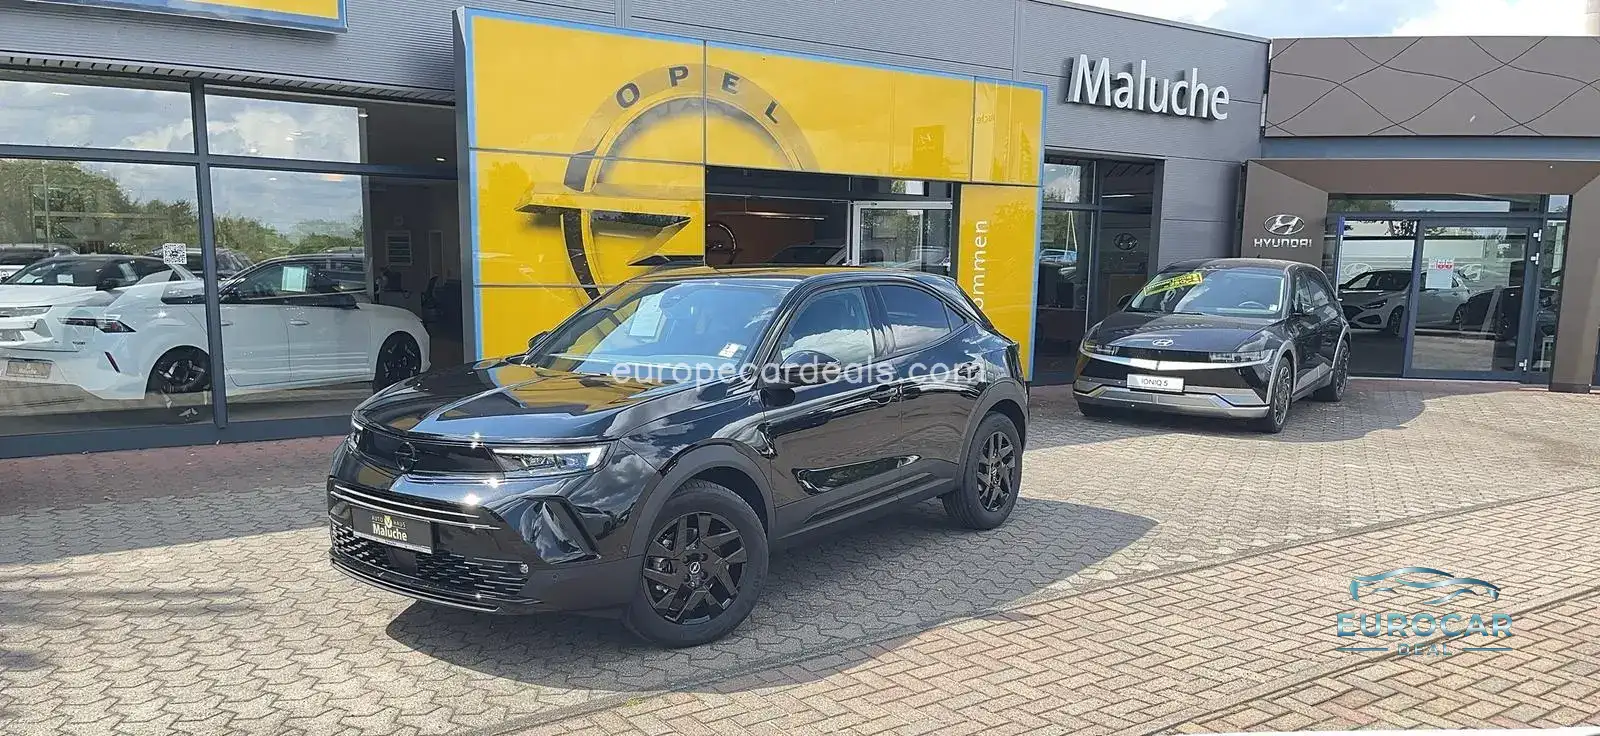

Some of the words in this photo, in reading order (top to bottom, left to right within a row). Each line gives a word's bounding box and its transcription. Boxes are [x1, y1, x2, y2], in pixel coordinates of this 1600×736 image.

[615, 65, 779, 125] OPEL
[1068, 53, 1230, 121] Maluche
[1253, 238, 1313, 248] HYUNDAI
[1142, 378, 1162, 386] IONIQ
[372, 523, 408, 541] Maluche
